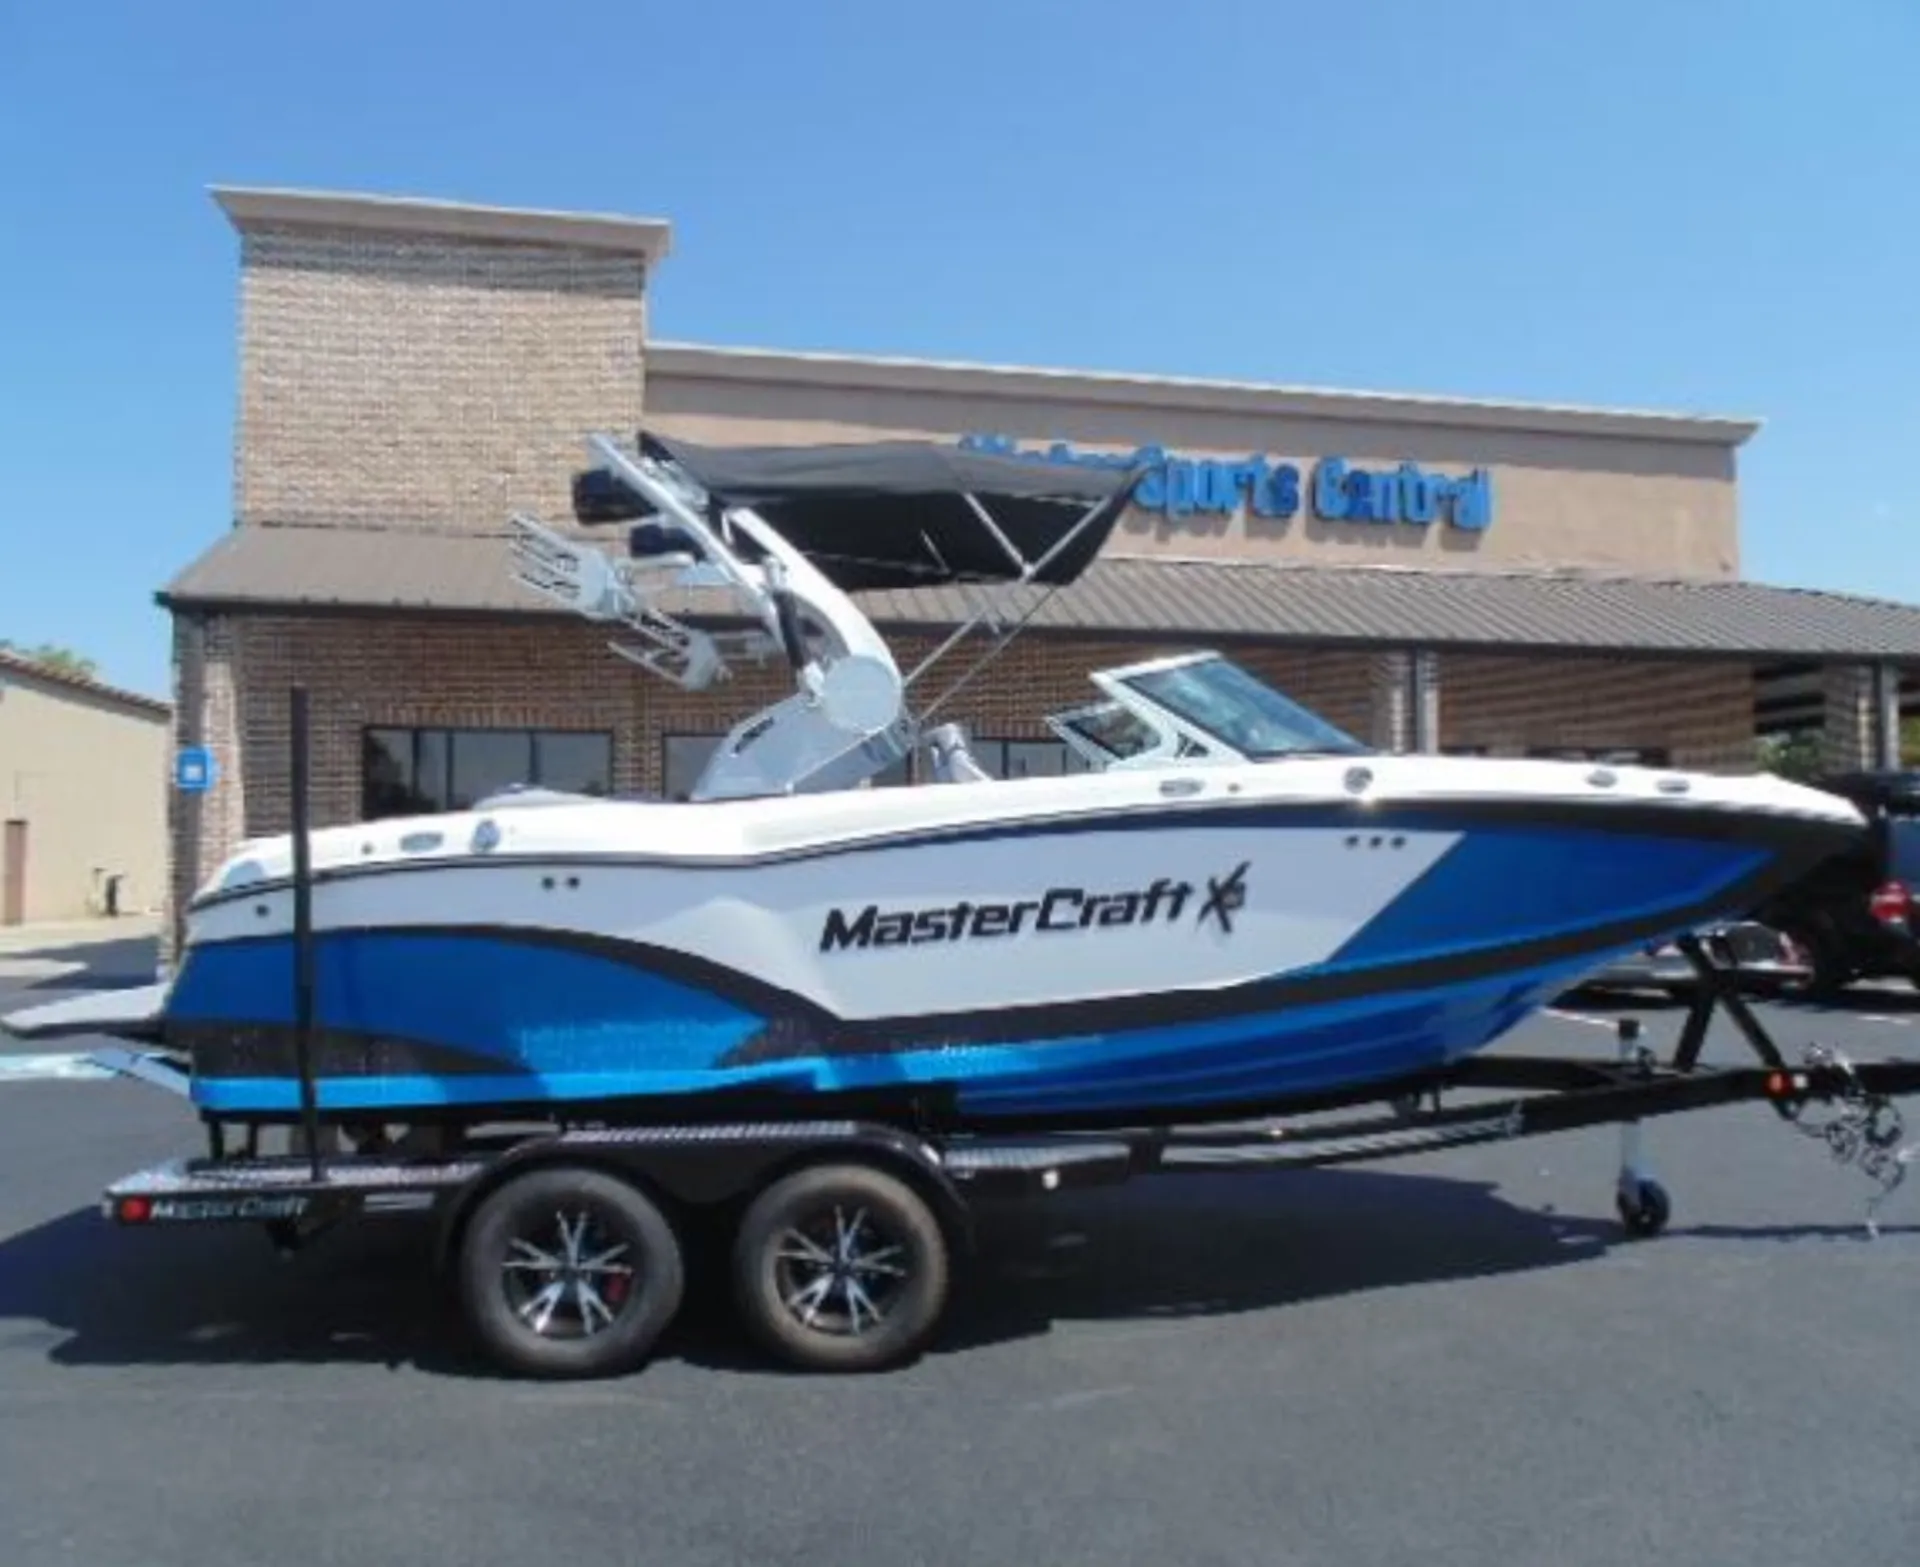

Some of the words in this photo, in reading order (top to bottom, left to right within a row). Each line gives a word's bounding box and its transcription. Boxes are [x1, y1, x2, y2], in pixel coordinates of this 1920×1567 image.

[1133, 445, 1299, 522] Sports
[1314, 456, 1490, 529] Central
[819, 880, 1193, 953] MasterCraft
